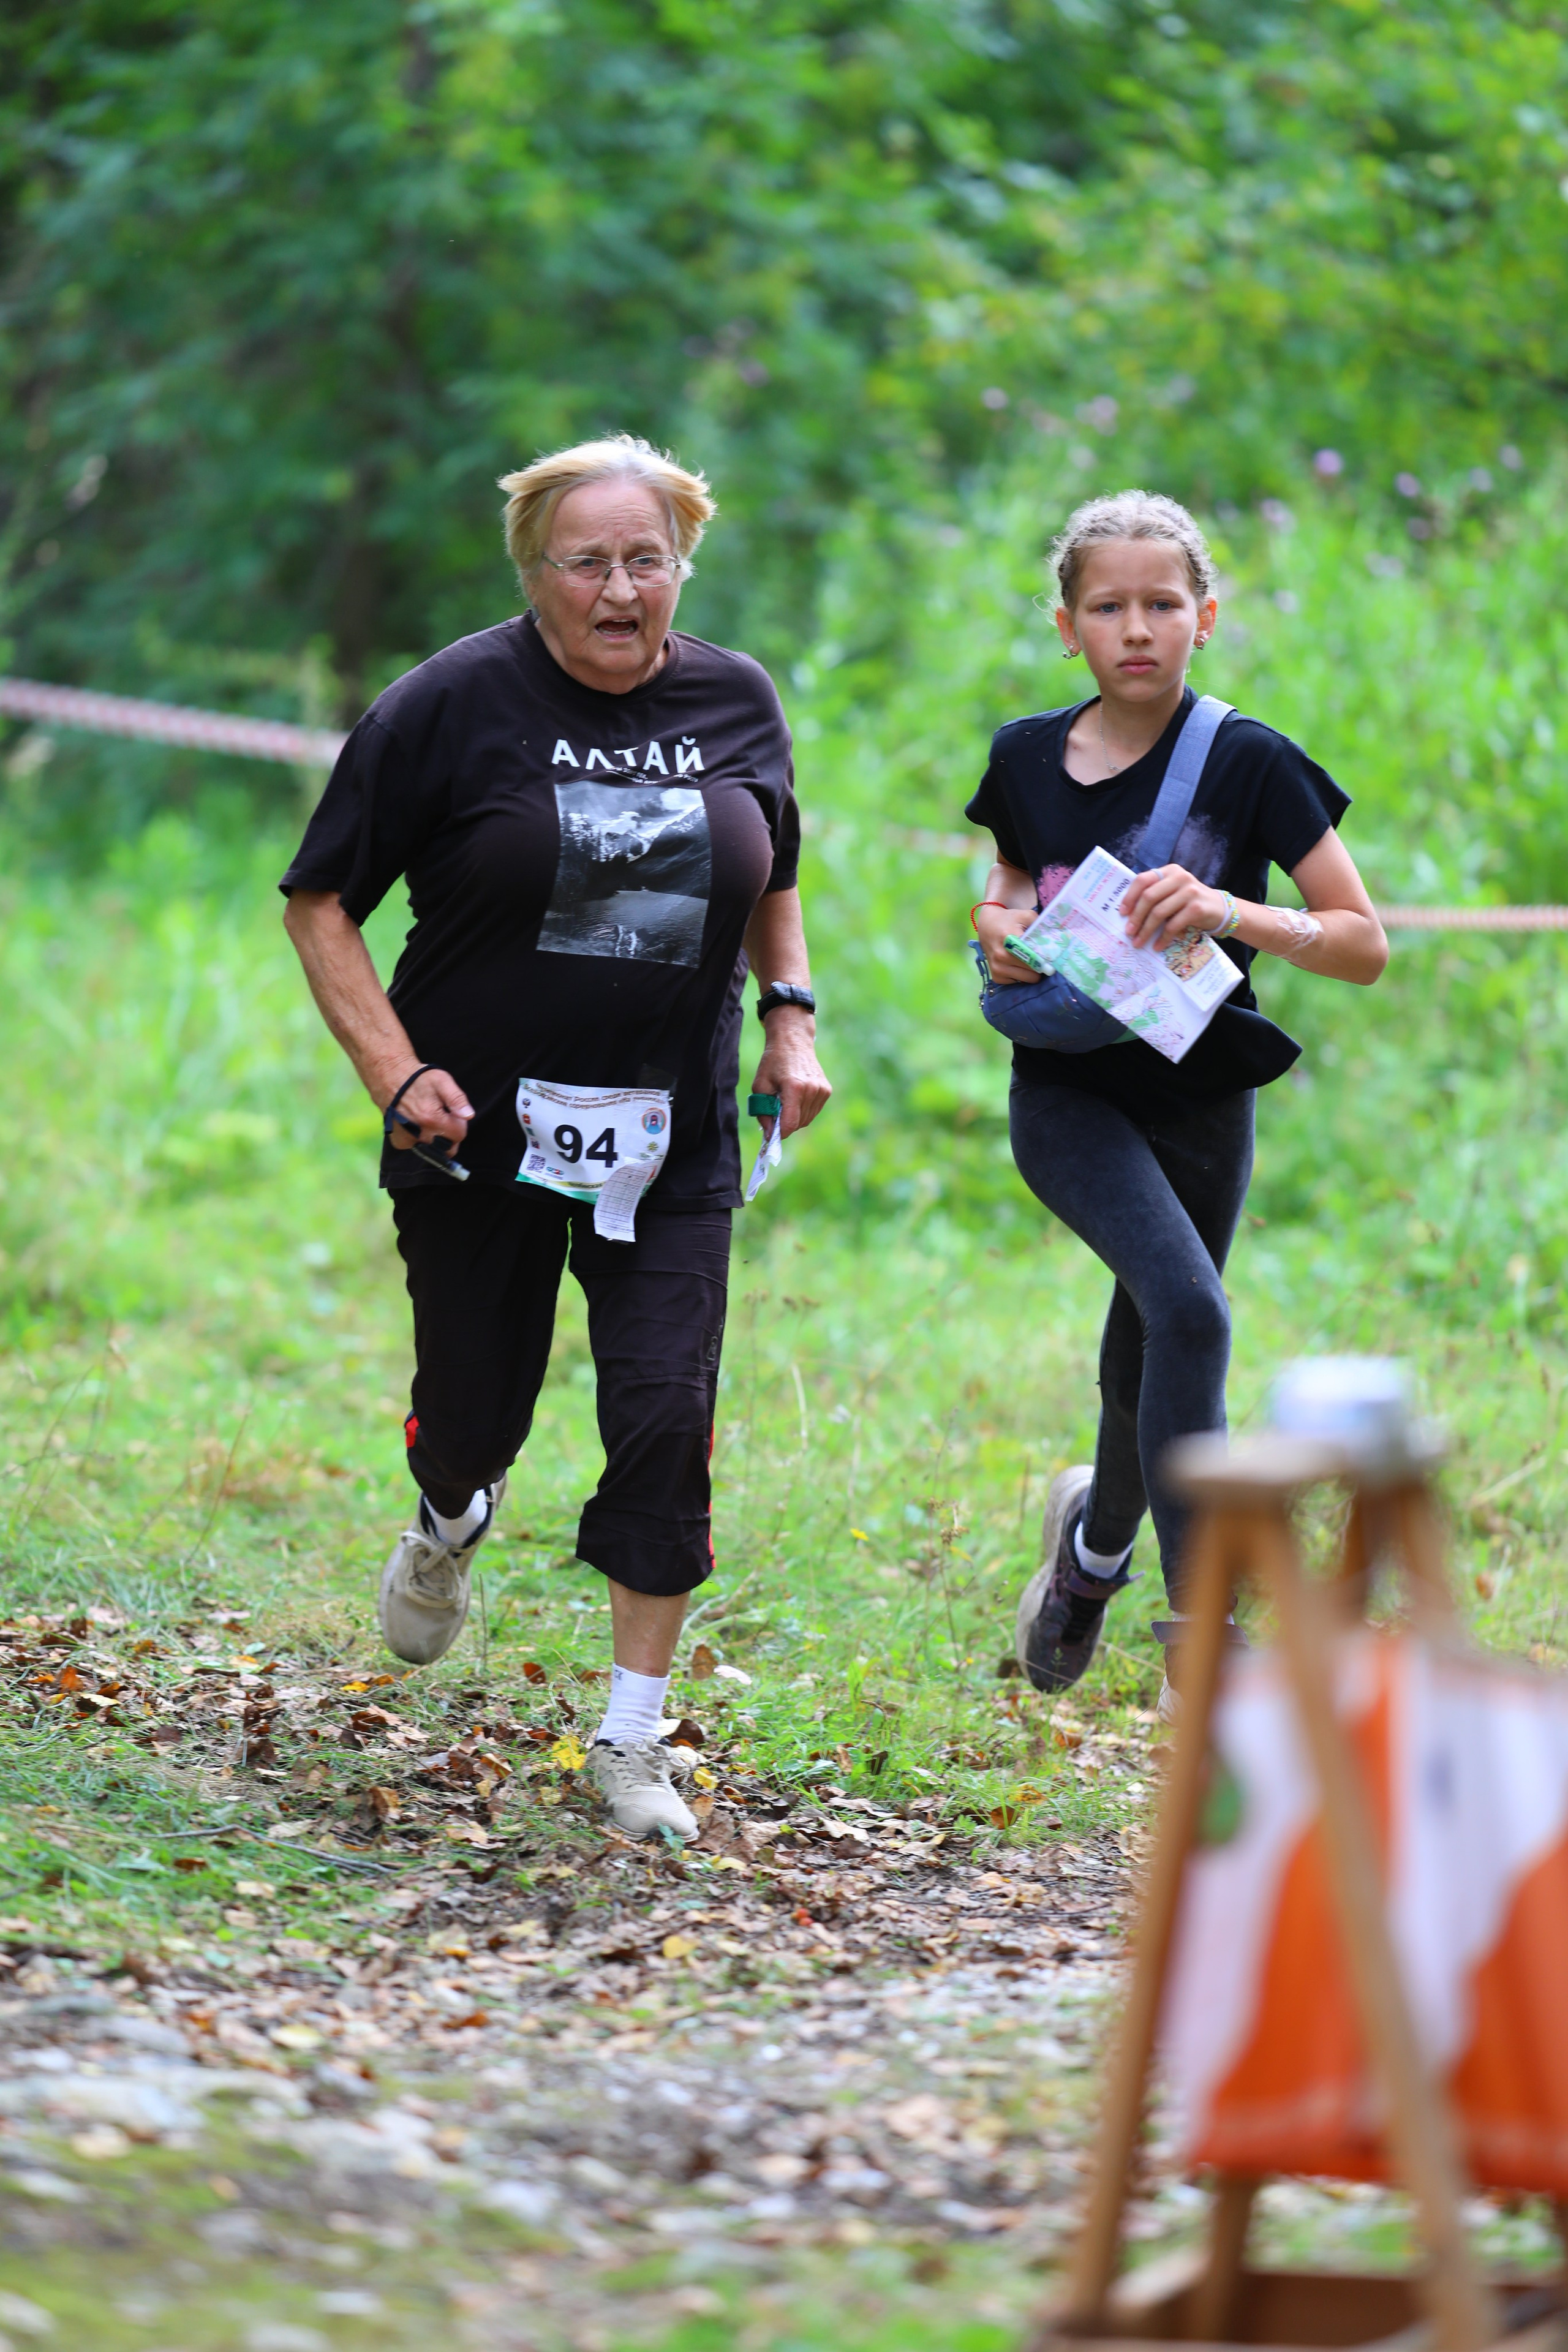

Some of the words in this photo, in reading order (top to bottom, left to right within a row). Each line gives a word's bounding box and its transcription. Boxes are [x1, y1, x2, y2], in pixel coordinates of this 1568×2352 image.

[551, 736, 706, 775] АЛТАЙ
[1108, 878, 1131, 903] 1:5000
[554, 1124, 619, 1168] 94
